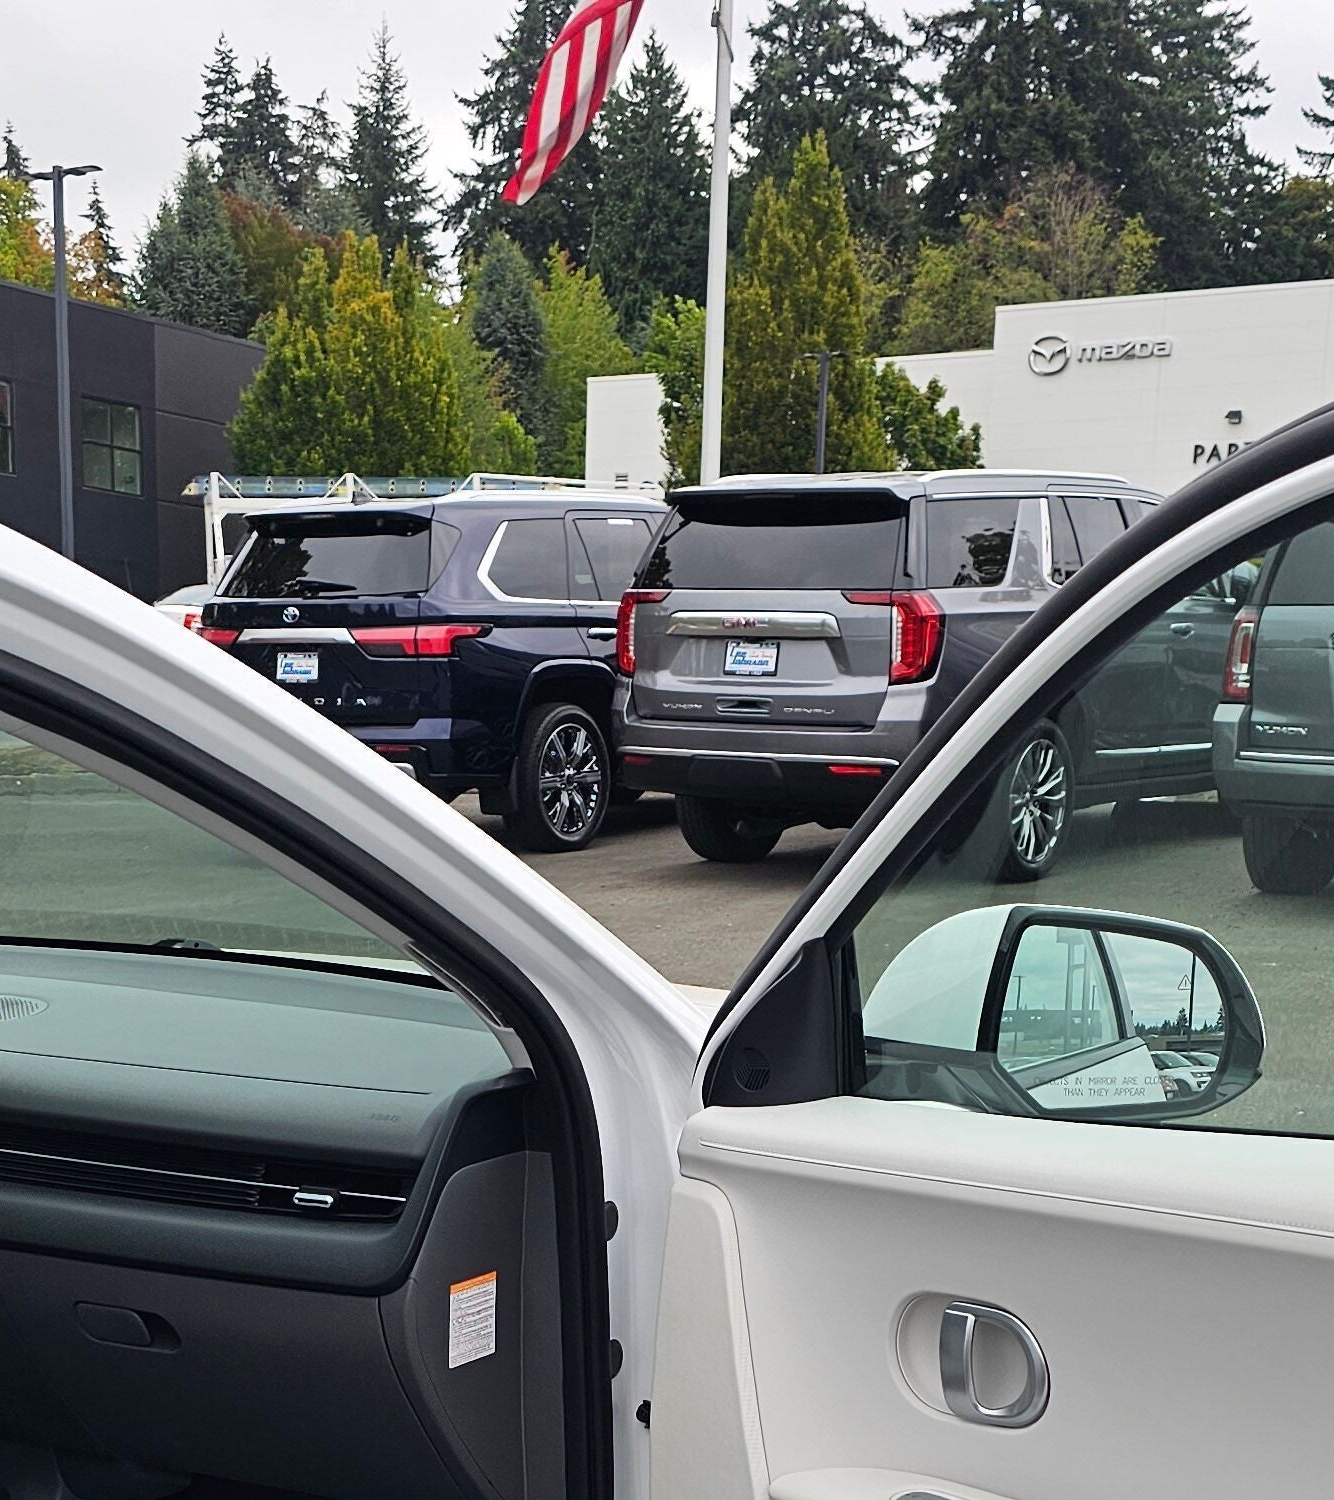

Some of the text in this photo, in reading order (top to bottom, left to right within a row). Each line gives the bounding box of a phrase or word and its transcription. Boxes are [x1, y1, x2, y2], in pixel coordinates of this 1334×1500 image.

[1193, 441, 1255, 464] PAR
[723, 616, 769, 628] GMC
[1088, 1076, 1118, 1086] MIRROR
[1123, 1076, 1139, 1085] ARE
[1063, 1087, 1146, 1097] THAN THEY APPEAR
